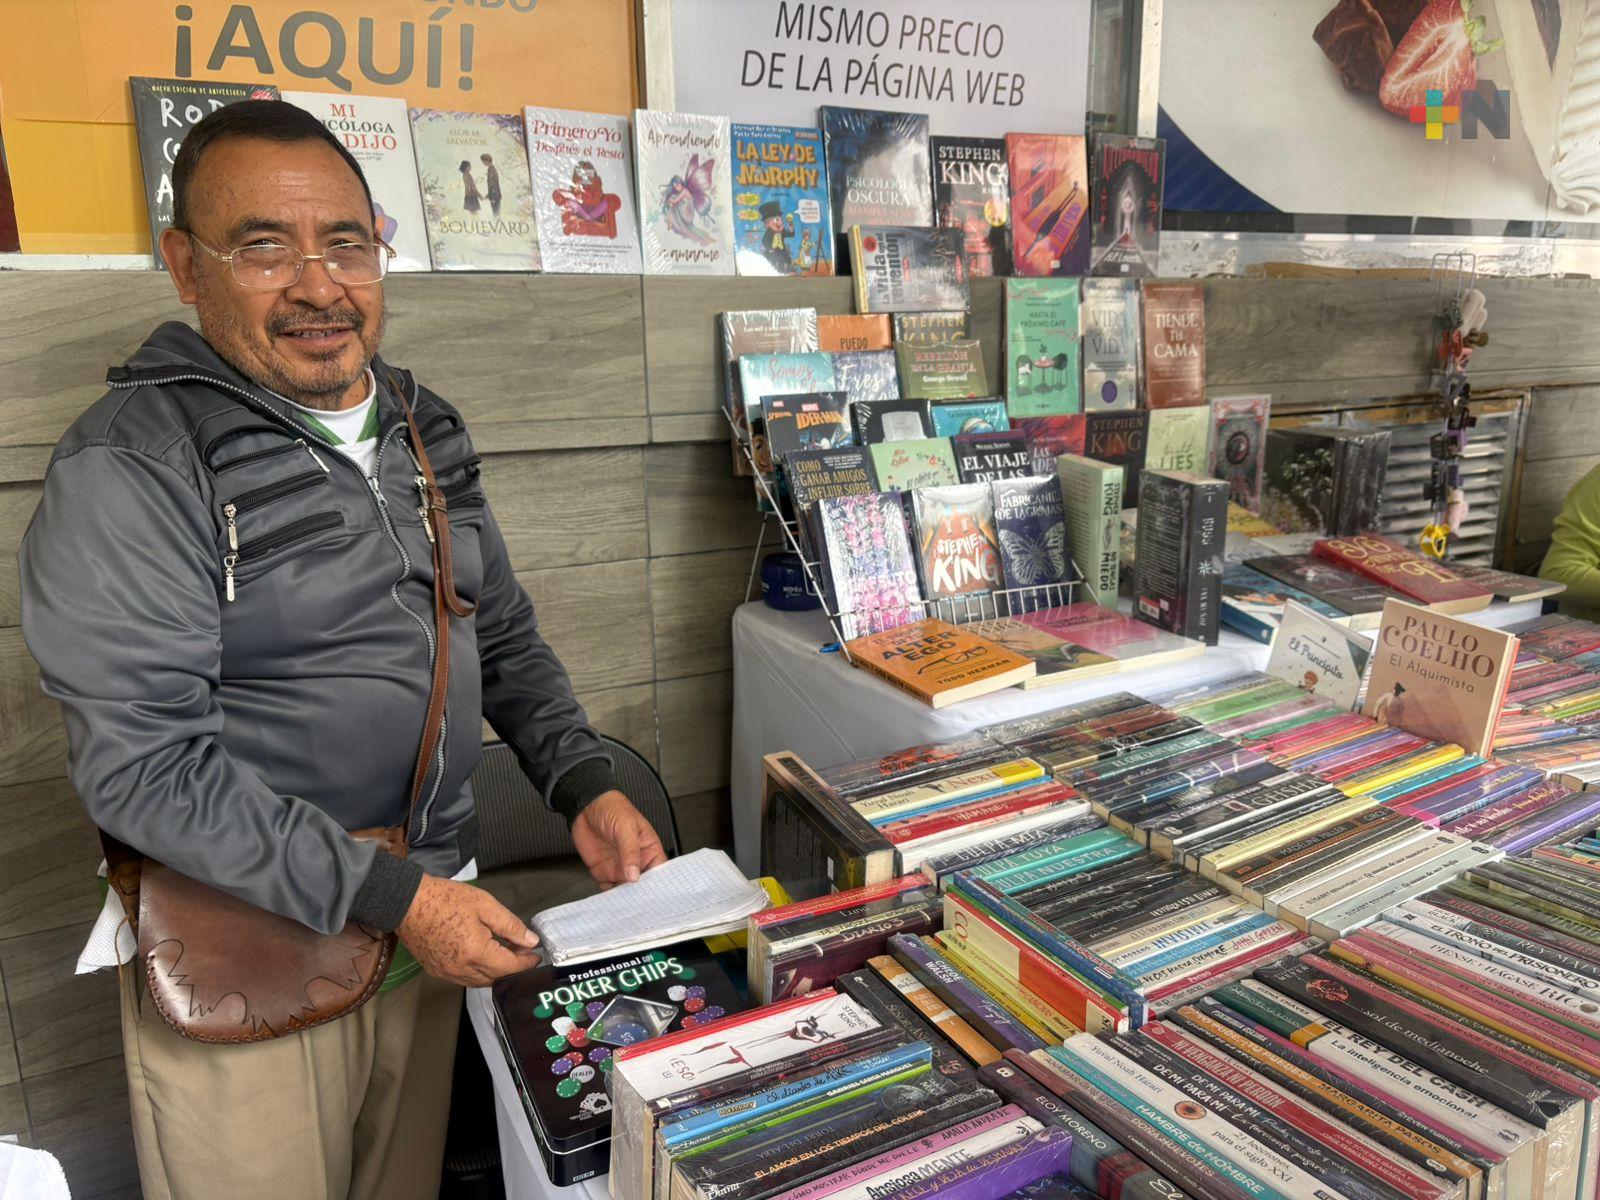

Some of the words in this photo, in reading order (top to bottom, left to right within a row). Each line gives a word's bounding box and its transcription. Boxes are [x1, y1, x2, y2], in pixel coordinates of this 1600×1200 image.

[775, 1, 889, 47] MISMO
[900, 14, 1003, 58] PRECIO
[175, 4, 474, 92] ¡AQUÍ!
[741, 49, 786, 90] DE
[798, 55, 833, 93] LA
[845, 53, 955, 103] PÁGINA
[965, 70, 1026, 107] WEB
[209, 88, 246, 97] ANIVERSARIO
[330, 103, 356, 118] MI
[344, 134, 397, 150] DIJO
[532, 120, 597, 142] Primero
[598, 127, 622, 143] Yo
[648, 129, 721, 149] Aprendiendo
[736, 141, 761, 163] LA
[762, 144, 791, 162] LEY
[795, 146, 816, 163] DE
[939, 146, 1001, 160] STEPHEN
[736, 163, 819, 189] MURPHY
[939, 161, 1009, 186] KING
[847, 189, 912, 206] OSCURA
[440, 220, 530, 236] BOULEVARD
[865, 254, 889, 294] vida
[902, 316, 965, 328] STEPHEN
[1154, 313, 1198, 329] TIENDE
[840, 337, 868, 350] PUEDO
[1154, 343, 1198, 358] CAMA
[839, 364, 883, 391] Eres
[1092, 417, 1144, 431] STEPHEN
[1091, 430, 1142, 454] KING
[796, 460, 821, 472] COMO
[963, 456, 984, 471] EL
[985, 452, 1030, 469] VIAJE
[800, 474, 832, 486] GANAR
[833, 469, 867, 482] AMIGOS
[997, 468, 1025, 480] LAS
[808, 487, 842, 499] INFLUIR
[844, 483, 872, 497] SOBRE
[1102, 483, 1114, 516] KING
[995, 507, 1012, 520] DE
[935, 532, 986, 555] STEPHEN
[933, 553, 999, 593] KING
[1100, 553, 1110, 590] MIEDO
[1403, 615, 1478, 652] PAULO
[882, 631, 958, 661] ALTER
[904, 641, 957, 662] EGO
[1383, 624, 1494, 679] COELHO
[1289, 636, 1301, 651] El
[1301, 643, 1344, 681] Principito
[937, 674, 964, 685] TODD
[968, 659, 1011, 676] HERMAN
[1389, 653, 1403, 668] El
[1407, 659, 1475, 694] Alquimista
[860, 795, 886, 808] Yuval
[888, 788, 914, 801] Noah
[877, 796, 909, 809] Harari
[1251, 777, 1326, 806] GEISHA
[954, 836, 1004, 861] CULPA
[1010, 828, 1048, 846] MÍA
[1022, 844, 1065, 862] TUYA
[1039, 847, 1118, 874] NUESTRA
[840, 906, 871, 917] Luna
[1429, 910, 1458, 924] BLACK
[843, 922, 893, 942] DIARIO
[1152, 922, 1214, 949] INVISIBLE
[1168, 959, 1192, 977] HASTA
[1192, 945, 1227, 966] SIEMPRE
[1253, 923, 1285, 940] GREEN
[1430, 944, 1475, 965] PIENSE
[1431, 924, 1443, 933] EL
[1443, 927, 1491, 949] TRONO
[1492, 944, 1507, 955] DEL
[1507, 951, 1600, 989] PRISIONERO
[569, 956, 641, 982] Professional
[924, 961, 955, 984] WALSH
[934, 960, 963, 982] CHLOE
[1278, 966, 1310, 981] MEYER
[539, 976, 616, 1010] POKER
[618, 957, 683, 988] CHIPS
[838, 1013, 856, 1029] KING
[842, 1005, 870, 1029] STEPHEN
[1363, 1008, 1385, 1023] sol
[1385, 1018, 1403, 1031] de
[1405, 1031, 1490, 1074] medianoche
[572, 1069, 593, 1078] DEALER
[1092, 1045, 1113, 1065] Yuval
[1115, 1057, 1136, 1075] Noah
[1136, 1073, 1163, 1094] Harari
[1184, 1044, 1232, 1079] VENGANZA
[1323, 1021, 1343, 1035] EL
[1348, 1032, 1389, 1053] REY
[1387, 1054, 1423, 1077] DEL
[1428, 1076, 1488, 1108] CASH
[826, 1080, 861, 1097] GABRIEL
[1153, 1064, 1168, 1076] DE
[1183, 1081, 1210, 1101] PARA
[1191, 1074, 1207, 1086] DE
[1220, 1090, 1247, 1109] PARA
[1331, 1040, 1346, 1050] La
[1347, 1049, 1412, 1085] inteligencia
[1413, 1084, 1478, 1120] emocional
[941, 1122, 972, 1141] AMALIA
[972, 1108, 1011, 1131] ANDRADE
[1036, 1096, 1060, 1114] ELOY
[1060, 1113, 1107, 1150] MORENO
[1318, 1083, 1394, 1128] MARGARITA
[1394, 1124, 1442, 1154] PASOS
[1136, 1104, 1192, 1143] HAMBRE
[1188, 1140, 1206, 1153] de
[1204, 1151, 1265, 1194] HOMBRE
[1233, 1132, 1247, 1143] 21
[1246, 1139, 1291, 1169] lecciones
[1425, 1127, 1462, 1150] TURNER
[754, 1171, 768, 1179] EL
[769, 1157, 800, 1174] AMOR
[799, 1152, 816, 1162] EN
[815, 1144, 834, 1157] LOS
[835, 1130, 873, 1148] TIEMPOS
[874, 1123, 891, 1136] DEL
[1211, 1129, 1232, 1148] para
[1234, 1143, 1244, 1154] el
[1244, 1151, 1268, 1171] siglo
[1268, 1166, 1294, 1185] XXI
[812, 1174, 851, 1191] MOSTRAR
[851, 1163, 878, 1178] DÓNDE
[879, 1157, 892, 1167] ME
[893, 1146, 918, 1164] DUELE
[1150, 1178, 1184, 1200] El
